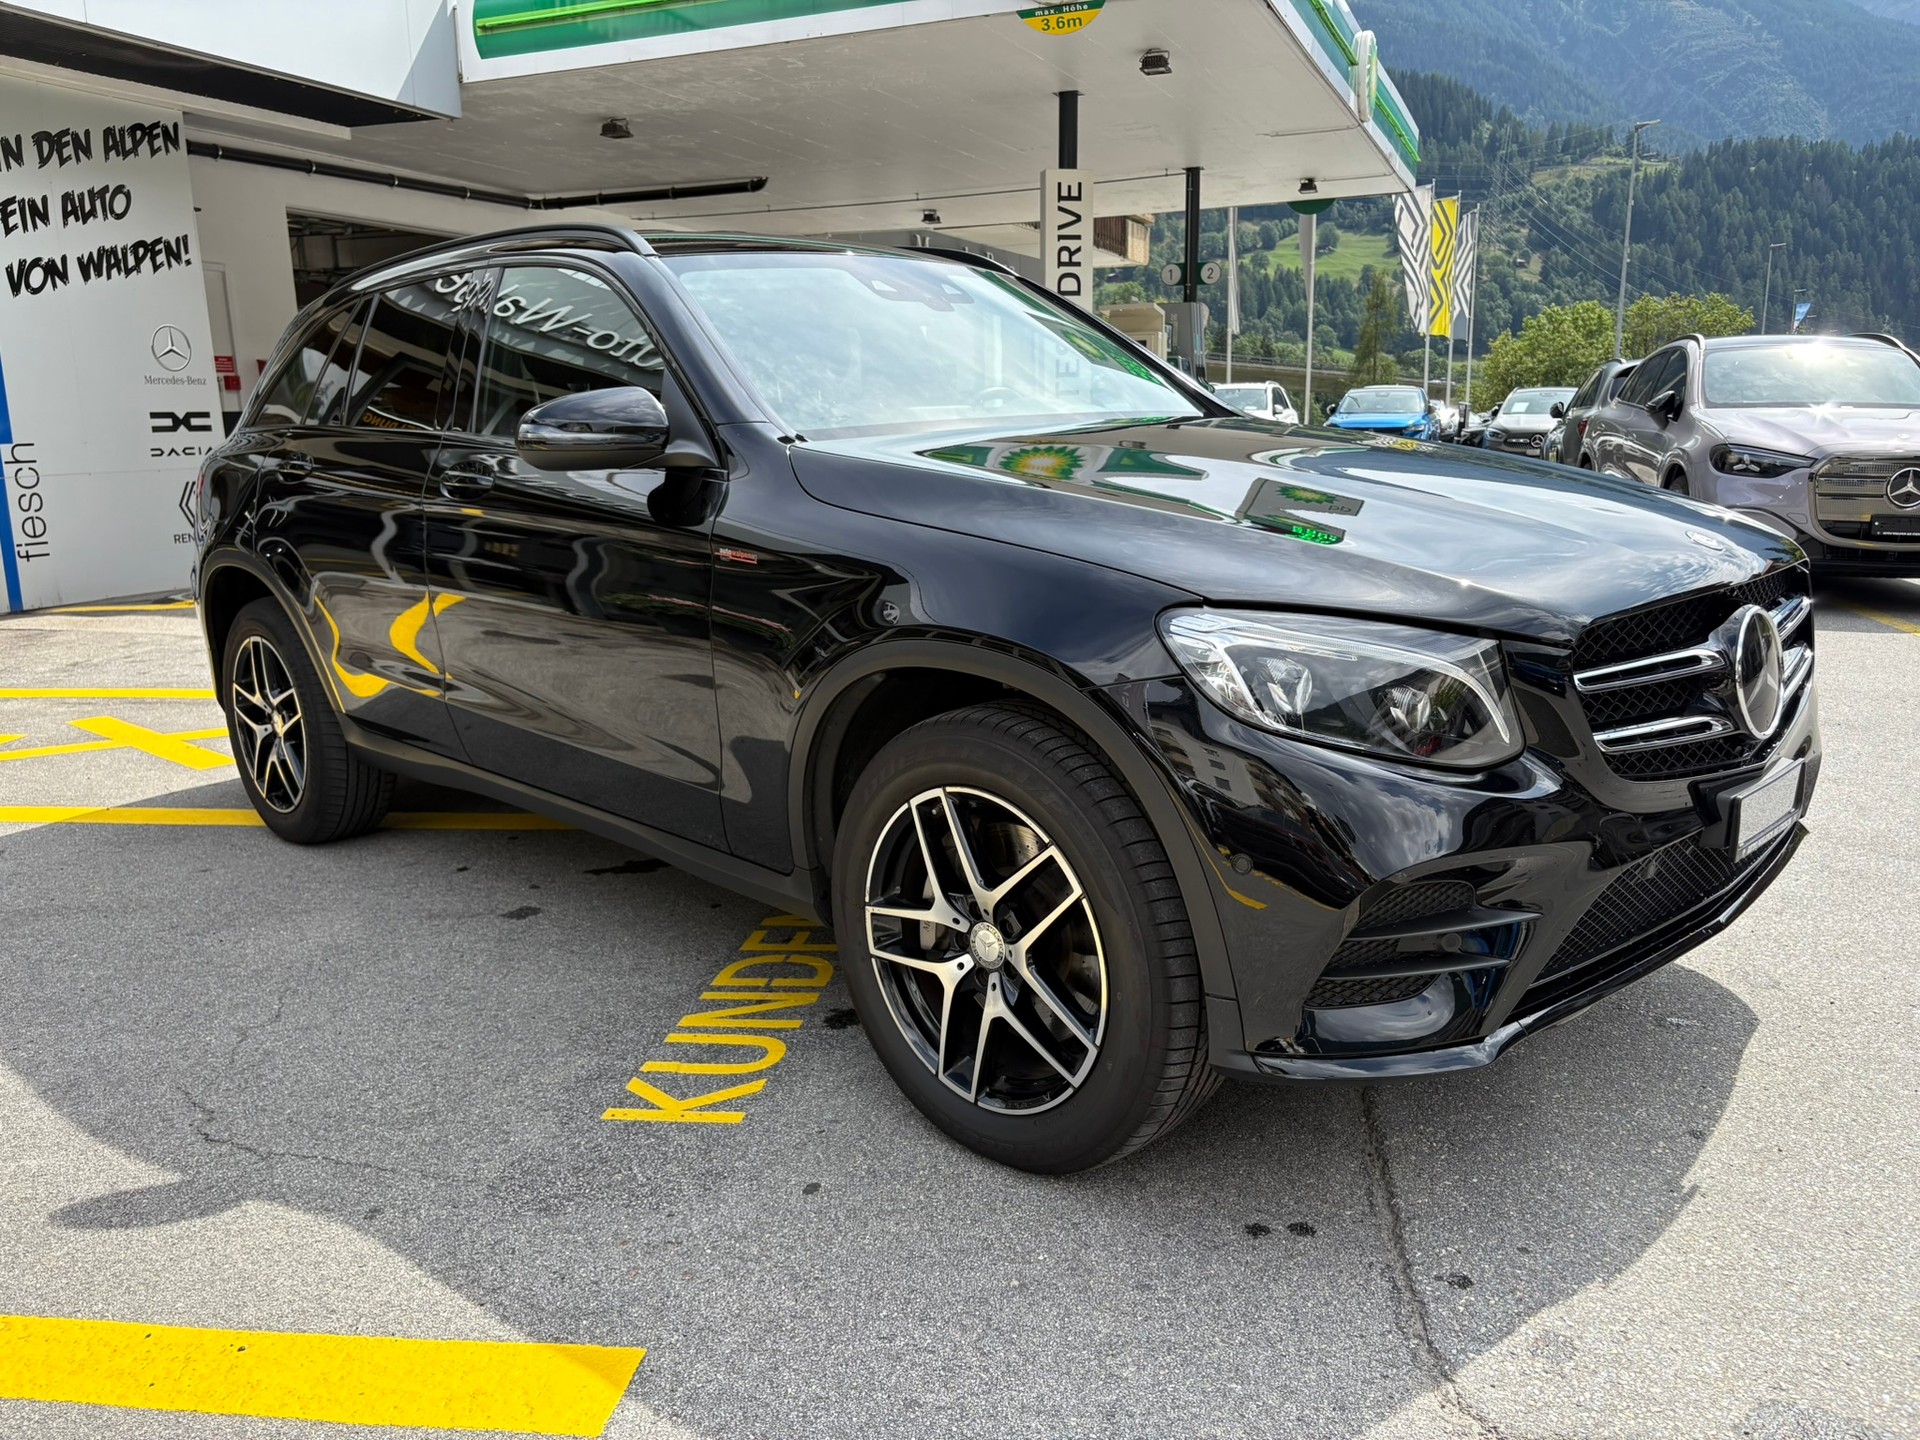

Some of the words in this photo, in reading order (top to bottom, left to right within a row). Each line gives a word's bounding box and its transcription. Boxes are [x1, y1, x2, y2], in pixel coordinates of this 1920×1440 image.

[1035, 9, 1059, 17] max.
[1062, 4, 1089, 13] Höhe
[1041, 16, 1083, 32] 3.6m
[31, 127, 93, 169] DEN
[103, 120, 181, 163] ALPEN
[0, 194, 50, 238] EIN
[61, 184, 132, 229] AUTO
[1057, 181, 1083, 297] DRIVE
[5, 253, 70, 298] VON
[77, 233, 192, 285] WALPEN!
[144, 375, 207, 386] Mercedes-Benz
[4, 442, 50, 563] fiesch
